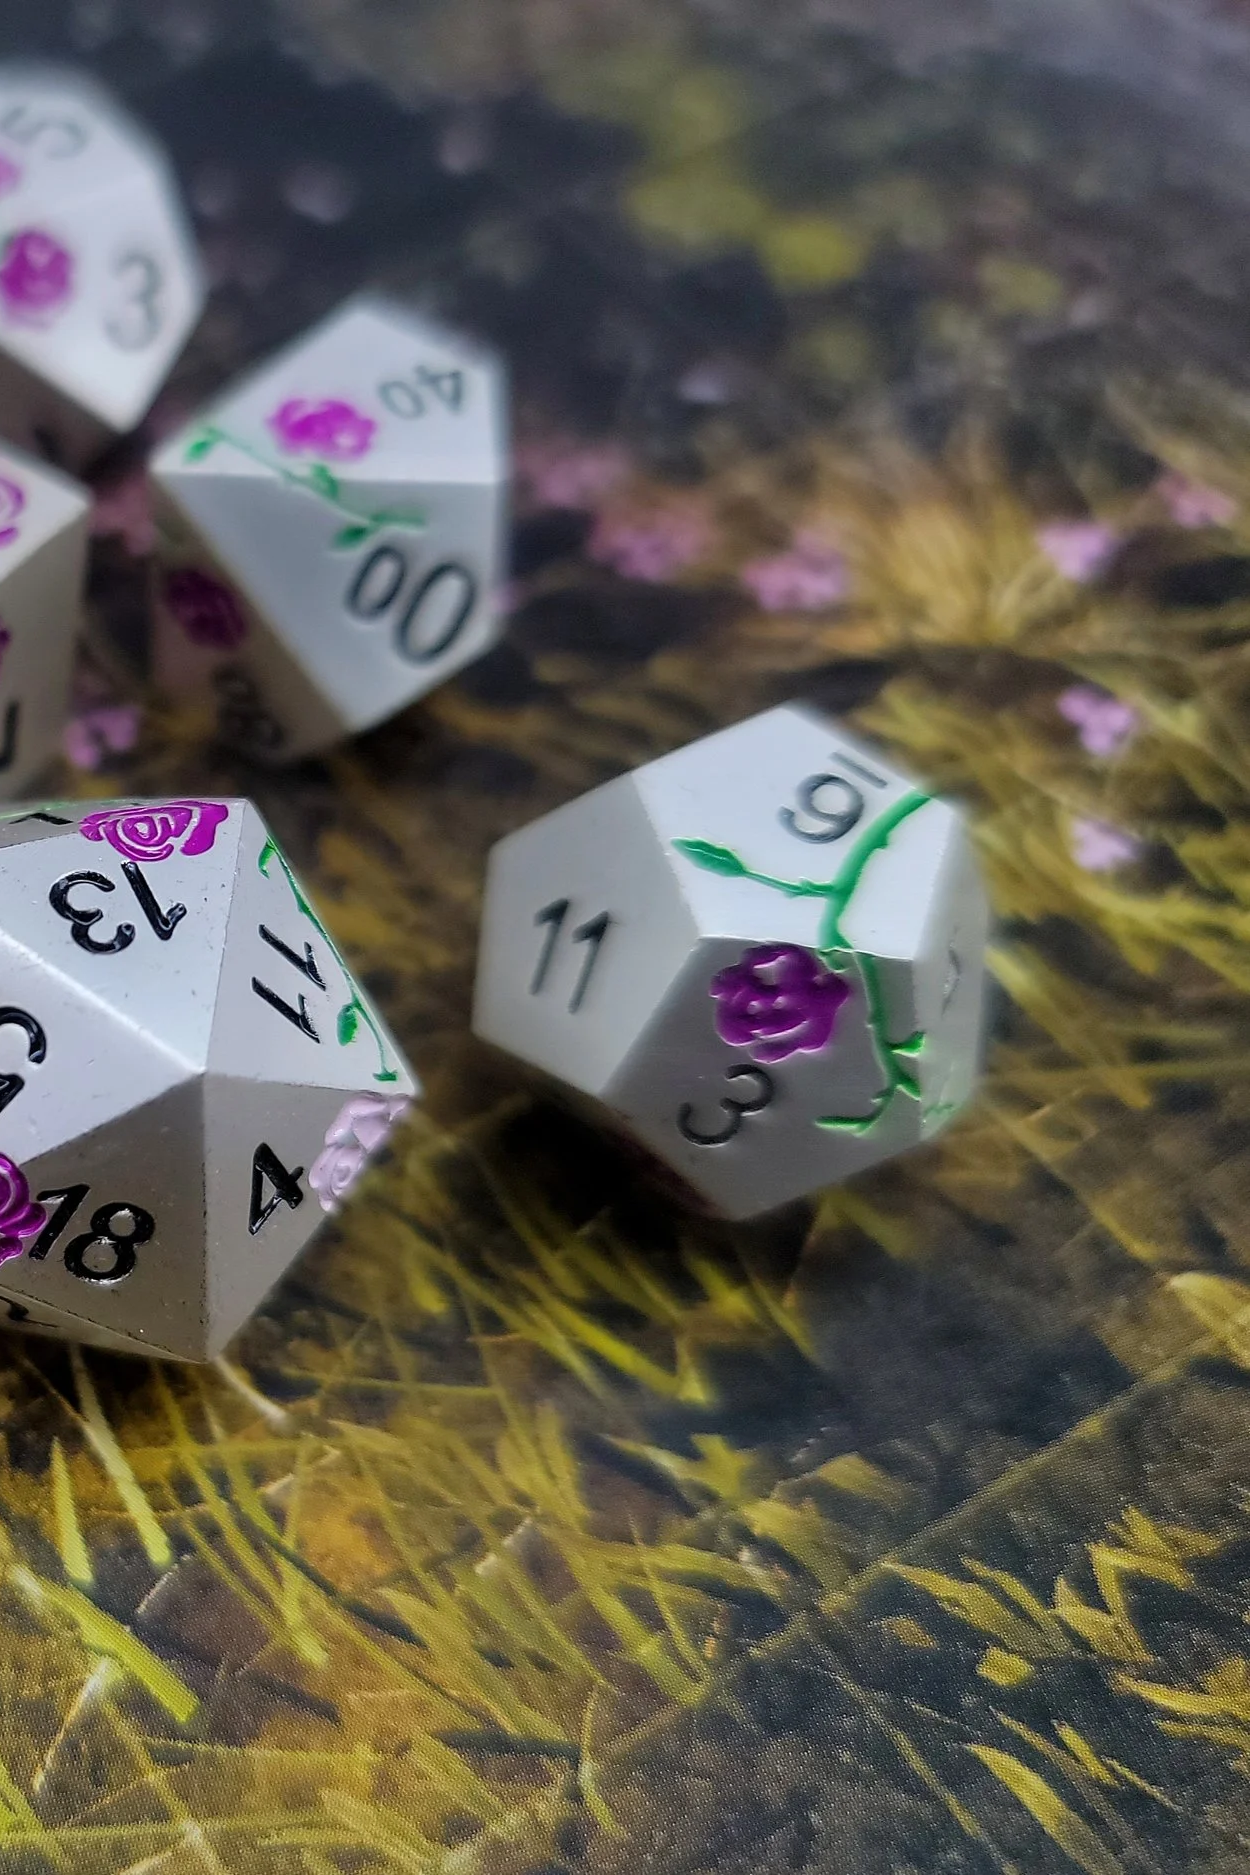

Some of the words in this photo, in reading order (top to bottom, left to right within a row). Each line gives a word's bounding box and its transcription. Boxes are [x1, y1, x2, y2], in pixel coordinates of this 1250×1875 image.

[103, 249, 162, 352] 3
[377, 365, 466, 421] 40
[347, 545, 476, 667] 00
[49, 861, 188, 955] 13
[530, 898, 613, 1015] 11
[252, 924, 327, 1044] 11
[677, 1064, 776, 1148] 3
[28, 1184, 156, 1286] 18
[249, 1142, 305, 1237] 4
